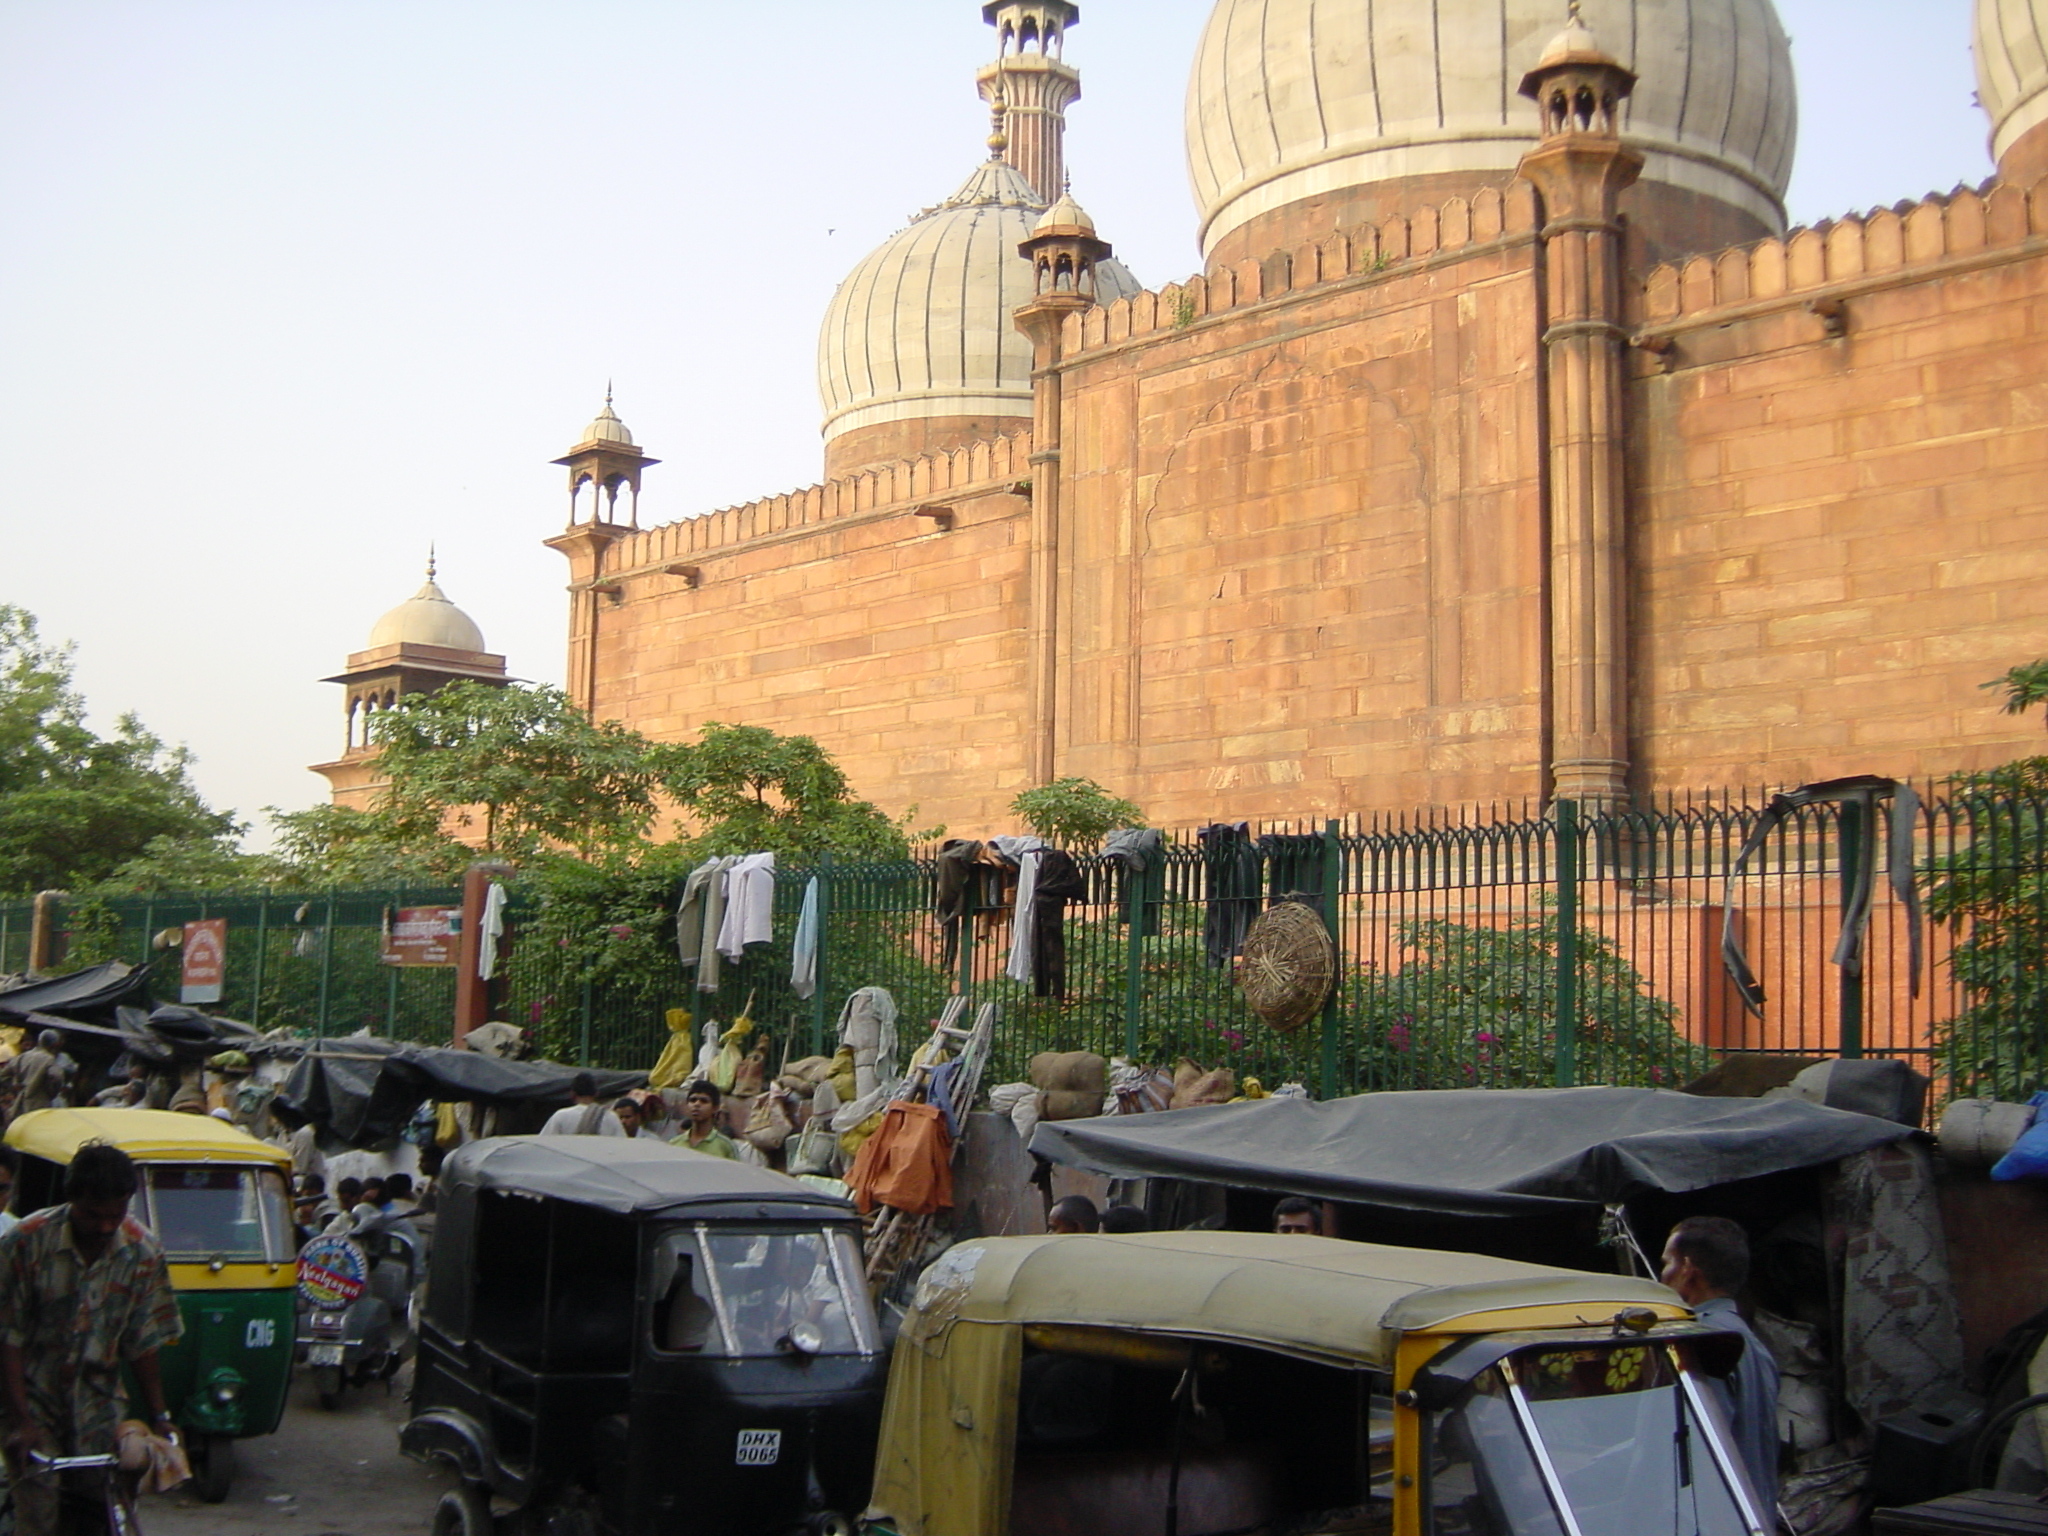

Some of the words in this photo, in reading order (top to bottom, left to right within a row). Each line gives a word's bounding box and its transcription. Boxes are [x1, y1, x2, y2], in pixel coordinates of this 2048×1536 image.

[331, 1239, 345, 1248] OF
[345, 1243, 367, 1281] QUALITY
[246, 1319, 276, 1348] CNG
[742, 1431, 778, 1446] DHX
[738, 1447, 777, 1463] 9065
